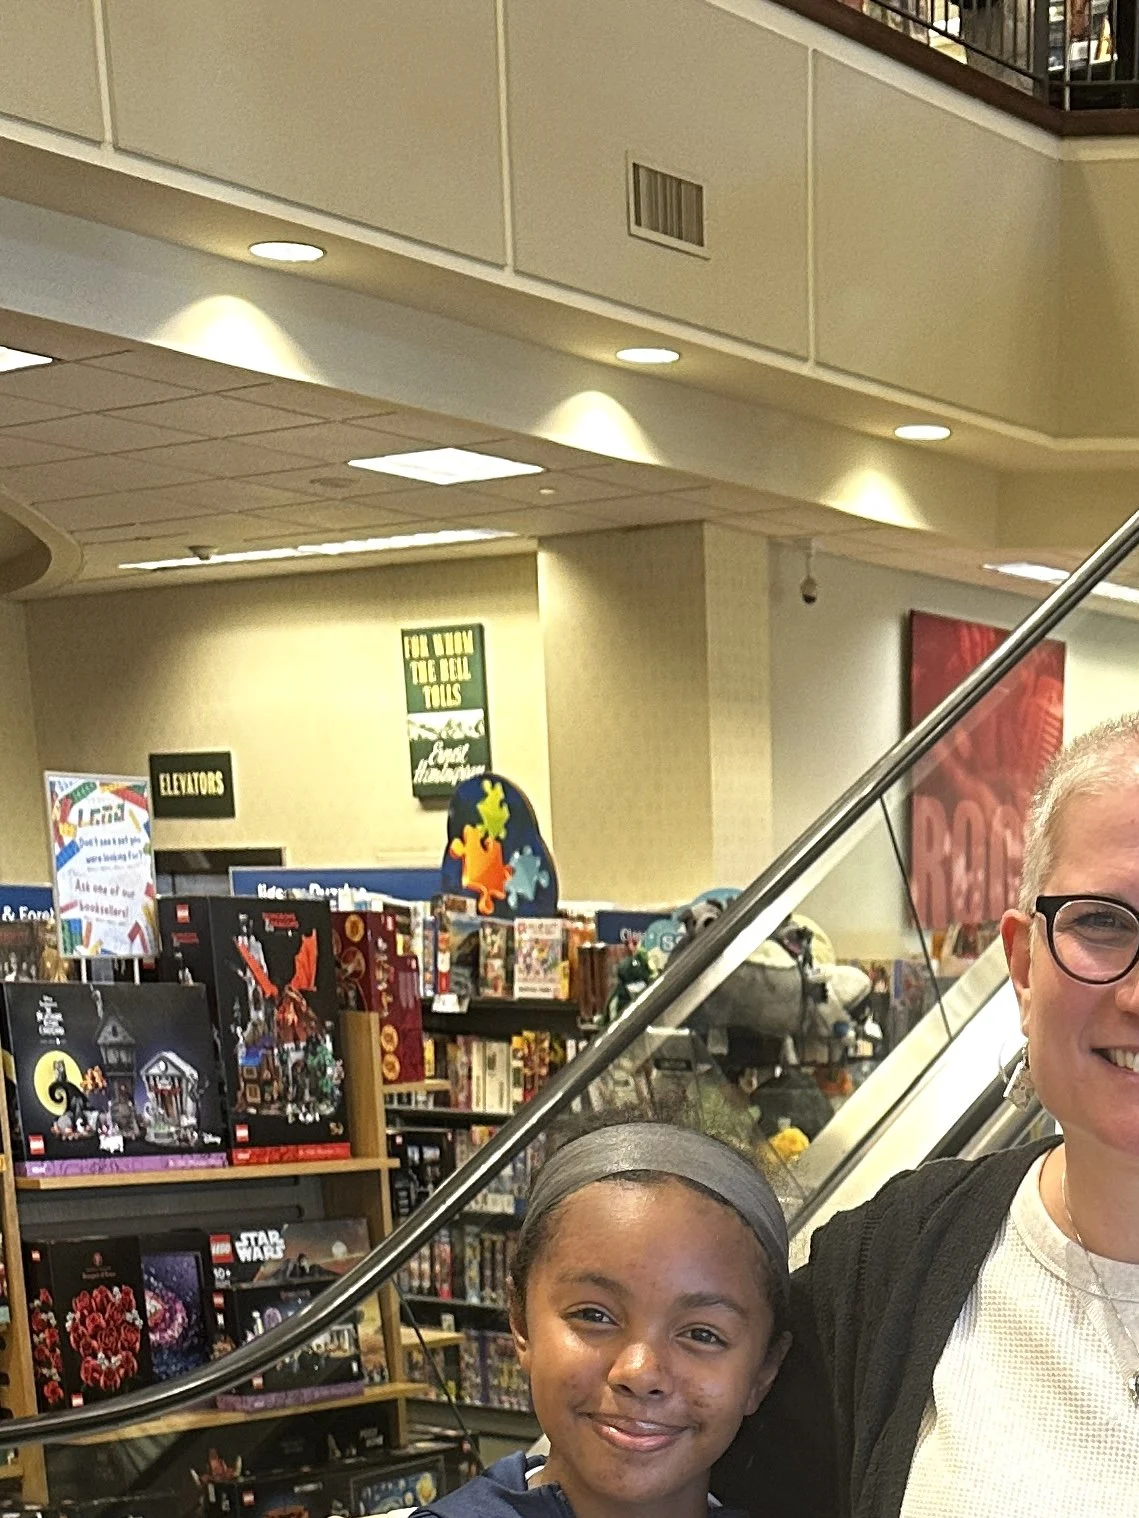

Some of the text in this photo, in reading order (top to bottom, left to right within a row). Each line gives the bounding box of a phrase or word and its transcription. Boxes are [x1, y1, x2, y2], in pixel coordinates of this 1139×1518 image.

[410, 655, 472, 685] THE BELL
[422, 683, 462, 709] TOLLS
[160, 771, 225, 796] ELEVATORS
[75, 879, 90, 892] Ask
[93, 883, 108, 895] one
[240, 1229, 282, 1247] STAR
[235, 1239, 286, 1263] WARS
